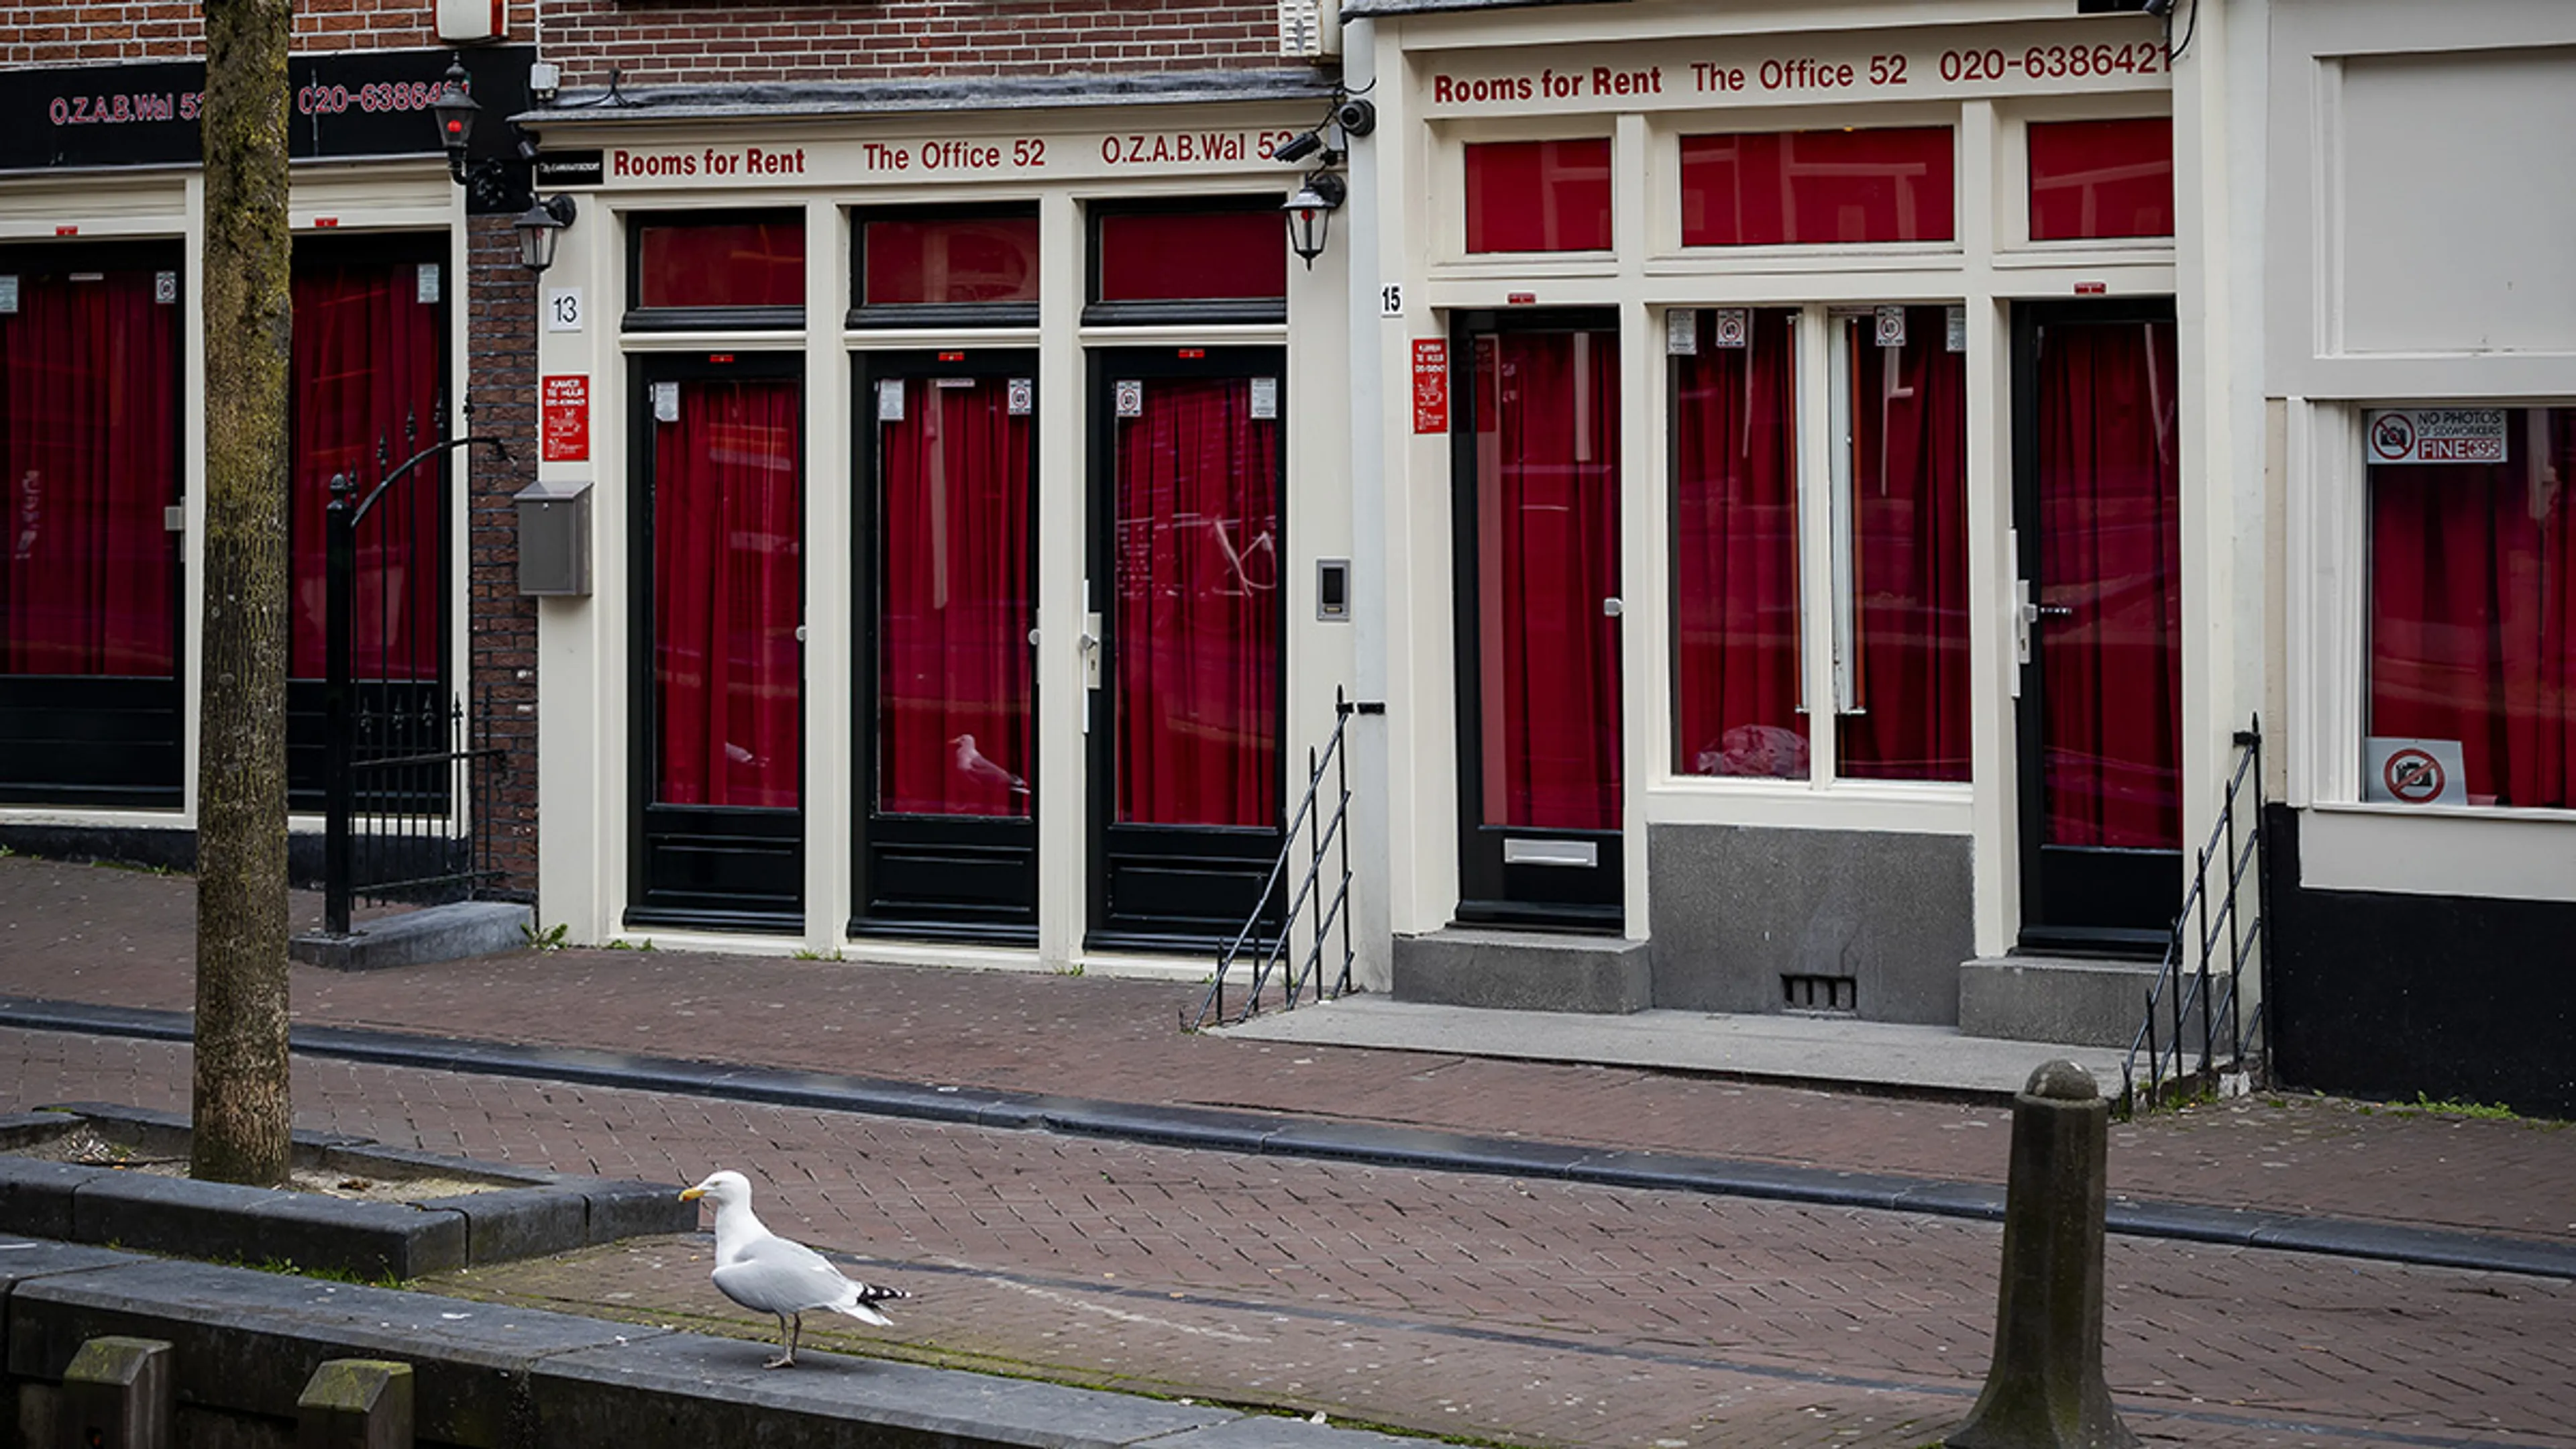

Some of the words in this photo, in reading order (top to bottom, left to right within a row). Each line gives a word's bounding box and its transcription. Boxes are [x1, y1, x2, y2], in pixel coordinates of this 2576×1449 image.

[1434, 75, 1533, 103] Rooms
[1542, 68, 1584, 97] for
[1592, 66, 1662, 95] Rent
[1690, 62, 1746, 91] The
[1760, 58, 1854, 89] Office
[1869, 54, 1907, 85] 52
[1940, 42, 2172, 81] 020-6386421
[50, 93, 173, 125] O.Z.A.B.Wal
[614, 150, 697, 176] Rooms
[704, 148, 739, 174] for
[747, 148, 805, 174] Rent
[863, 144, 910, 170] The
[921, 142, 1001, 168] Office
[1013, 139, 1045, 167] 52
[1102, 133, 1245, 164] O.Z.A.B.Wal
[553, 296, 577, 323] 13
[1382, 286, 1401, 312] 15
[2417, 411, 2440, 425] NO
[2443, 411, 2502, 425] PHOTOS
[2421, 439, 2466, 458] FINE
